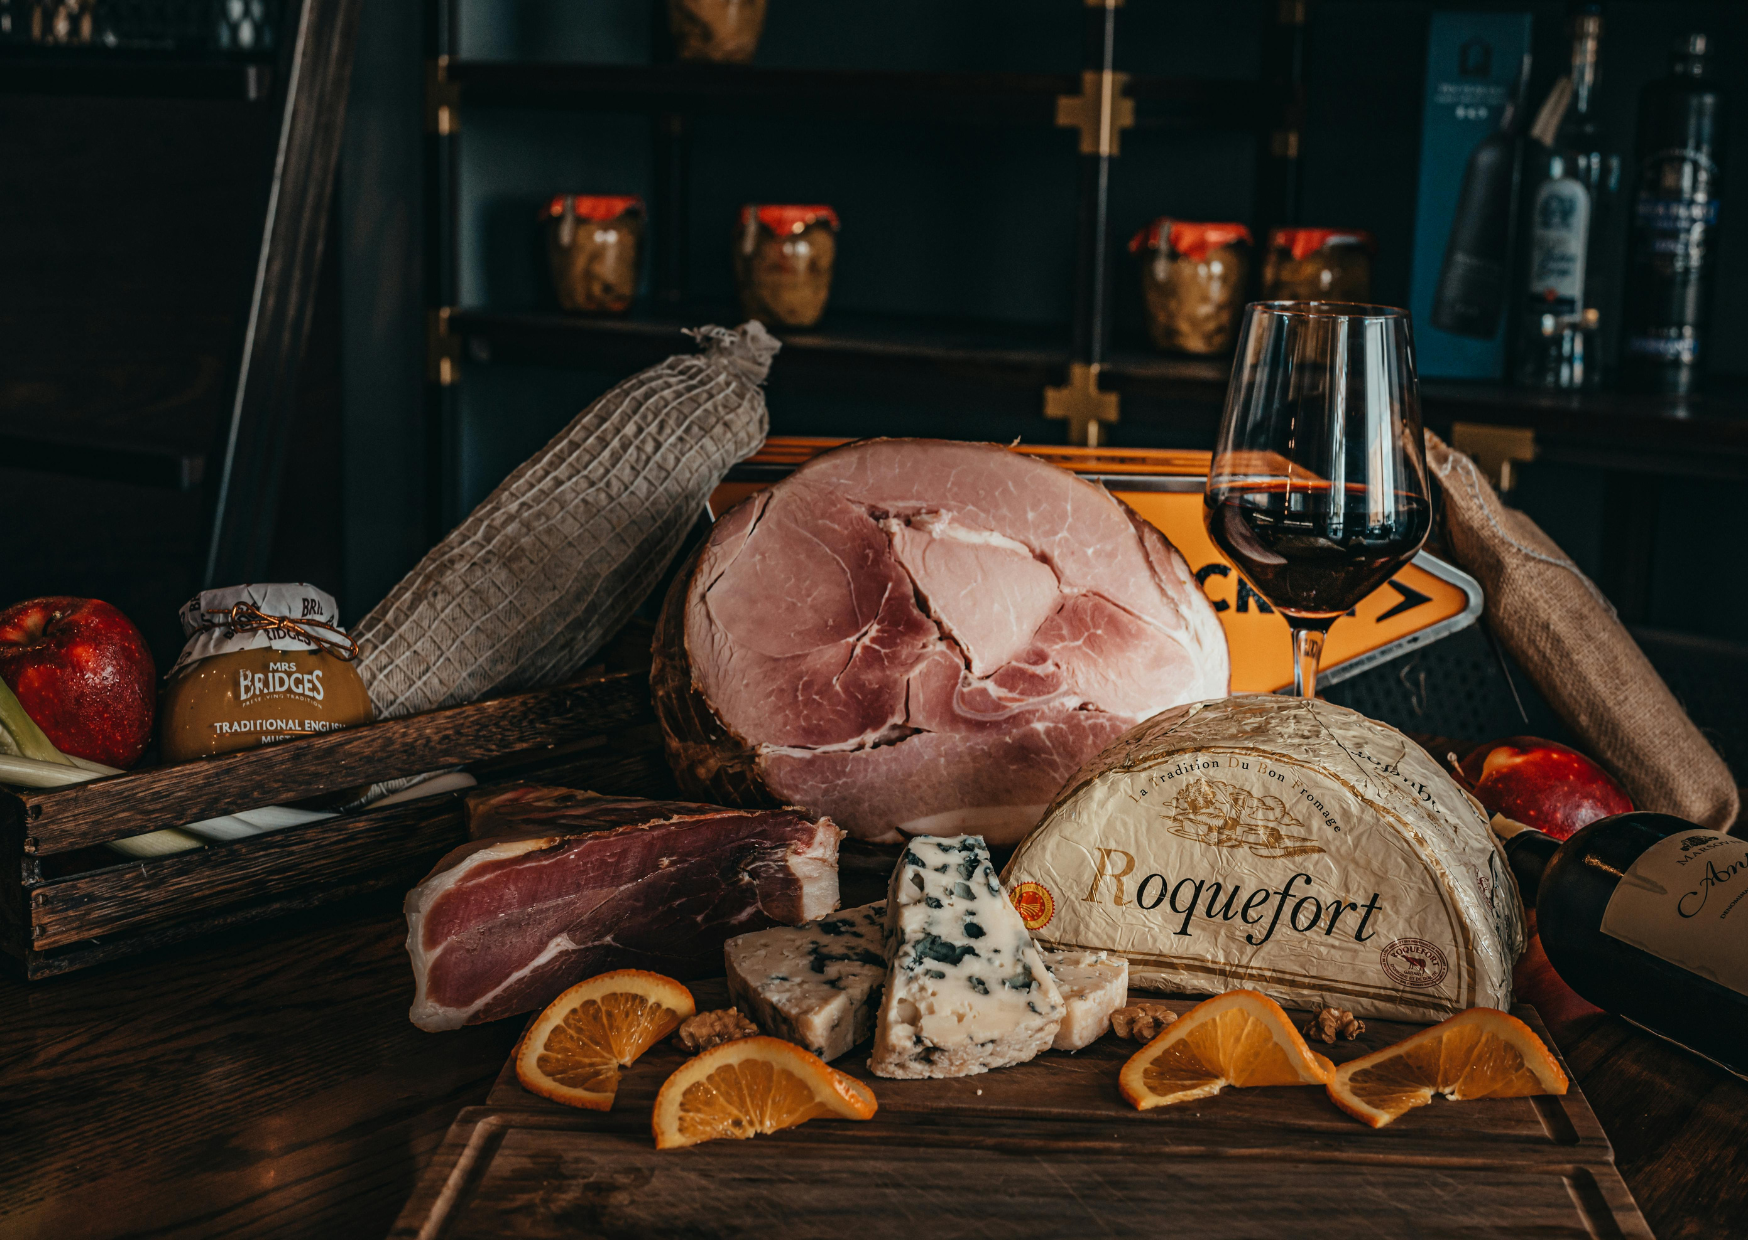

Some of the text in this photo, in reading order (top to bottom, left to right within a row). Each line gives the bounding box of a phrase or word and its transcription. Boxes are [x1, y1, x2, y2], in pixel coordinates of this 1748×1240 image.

[269, 662, 297, 671] MRS
[239, 669, 324, 700] BRIDGES
[286, 694, 323, 709] TRADITION
[214, 719, 302, 733] TRADITIONAL
[1128, 757, 1341, 833] La Tradition Du Bon Fromage
[1081, 846, 1383, 946] Roquefort
[1390, 945, 1440, 967] ROQUEFORT
